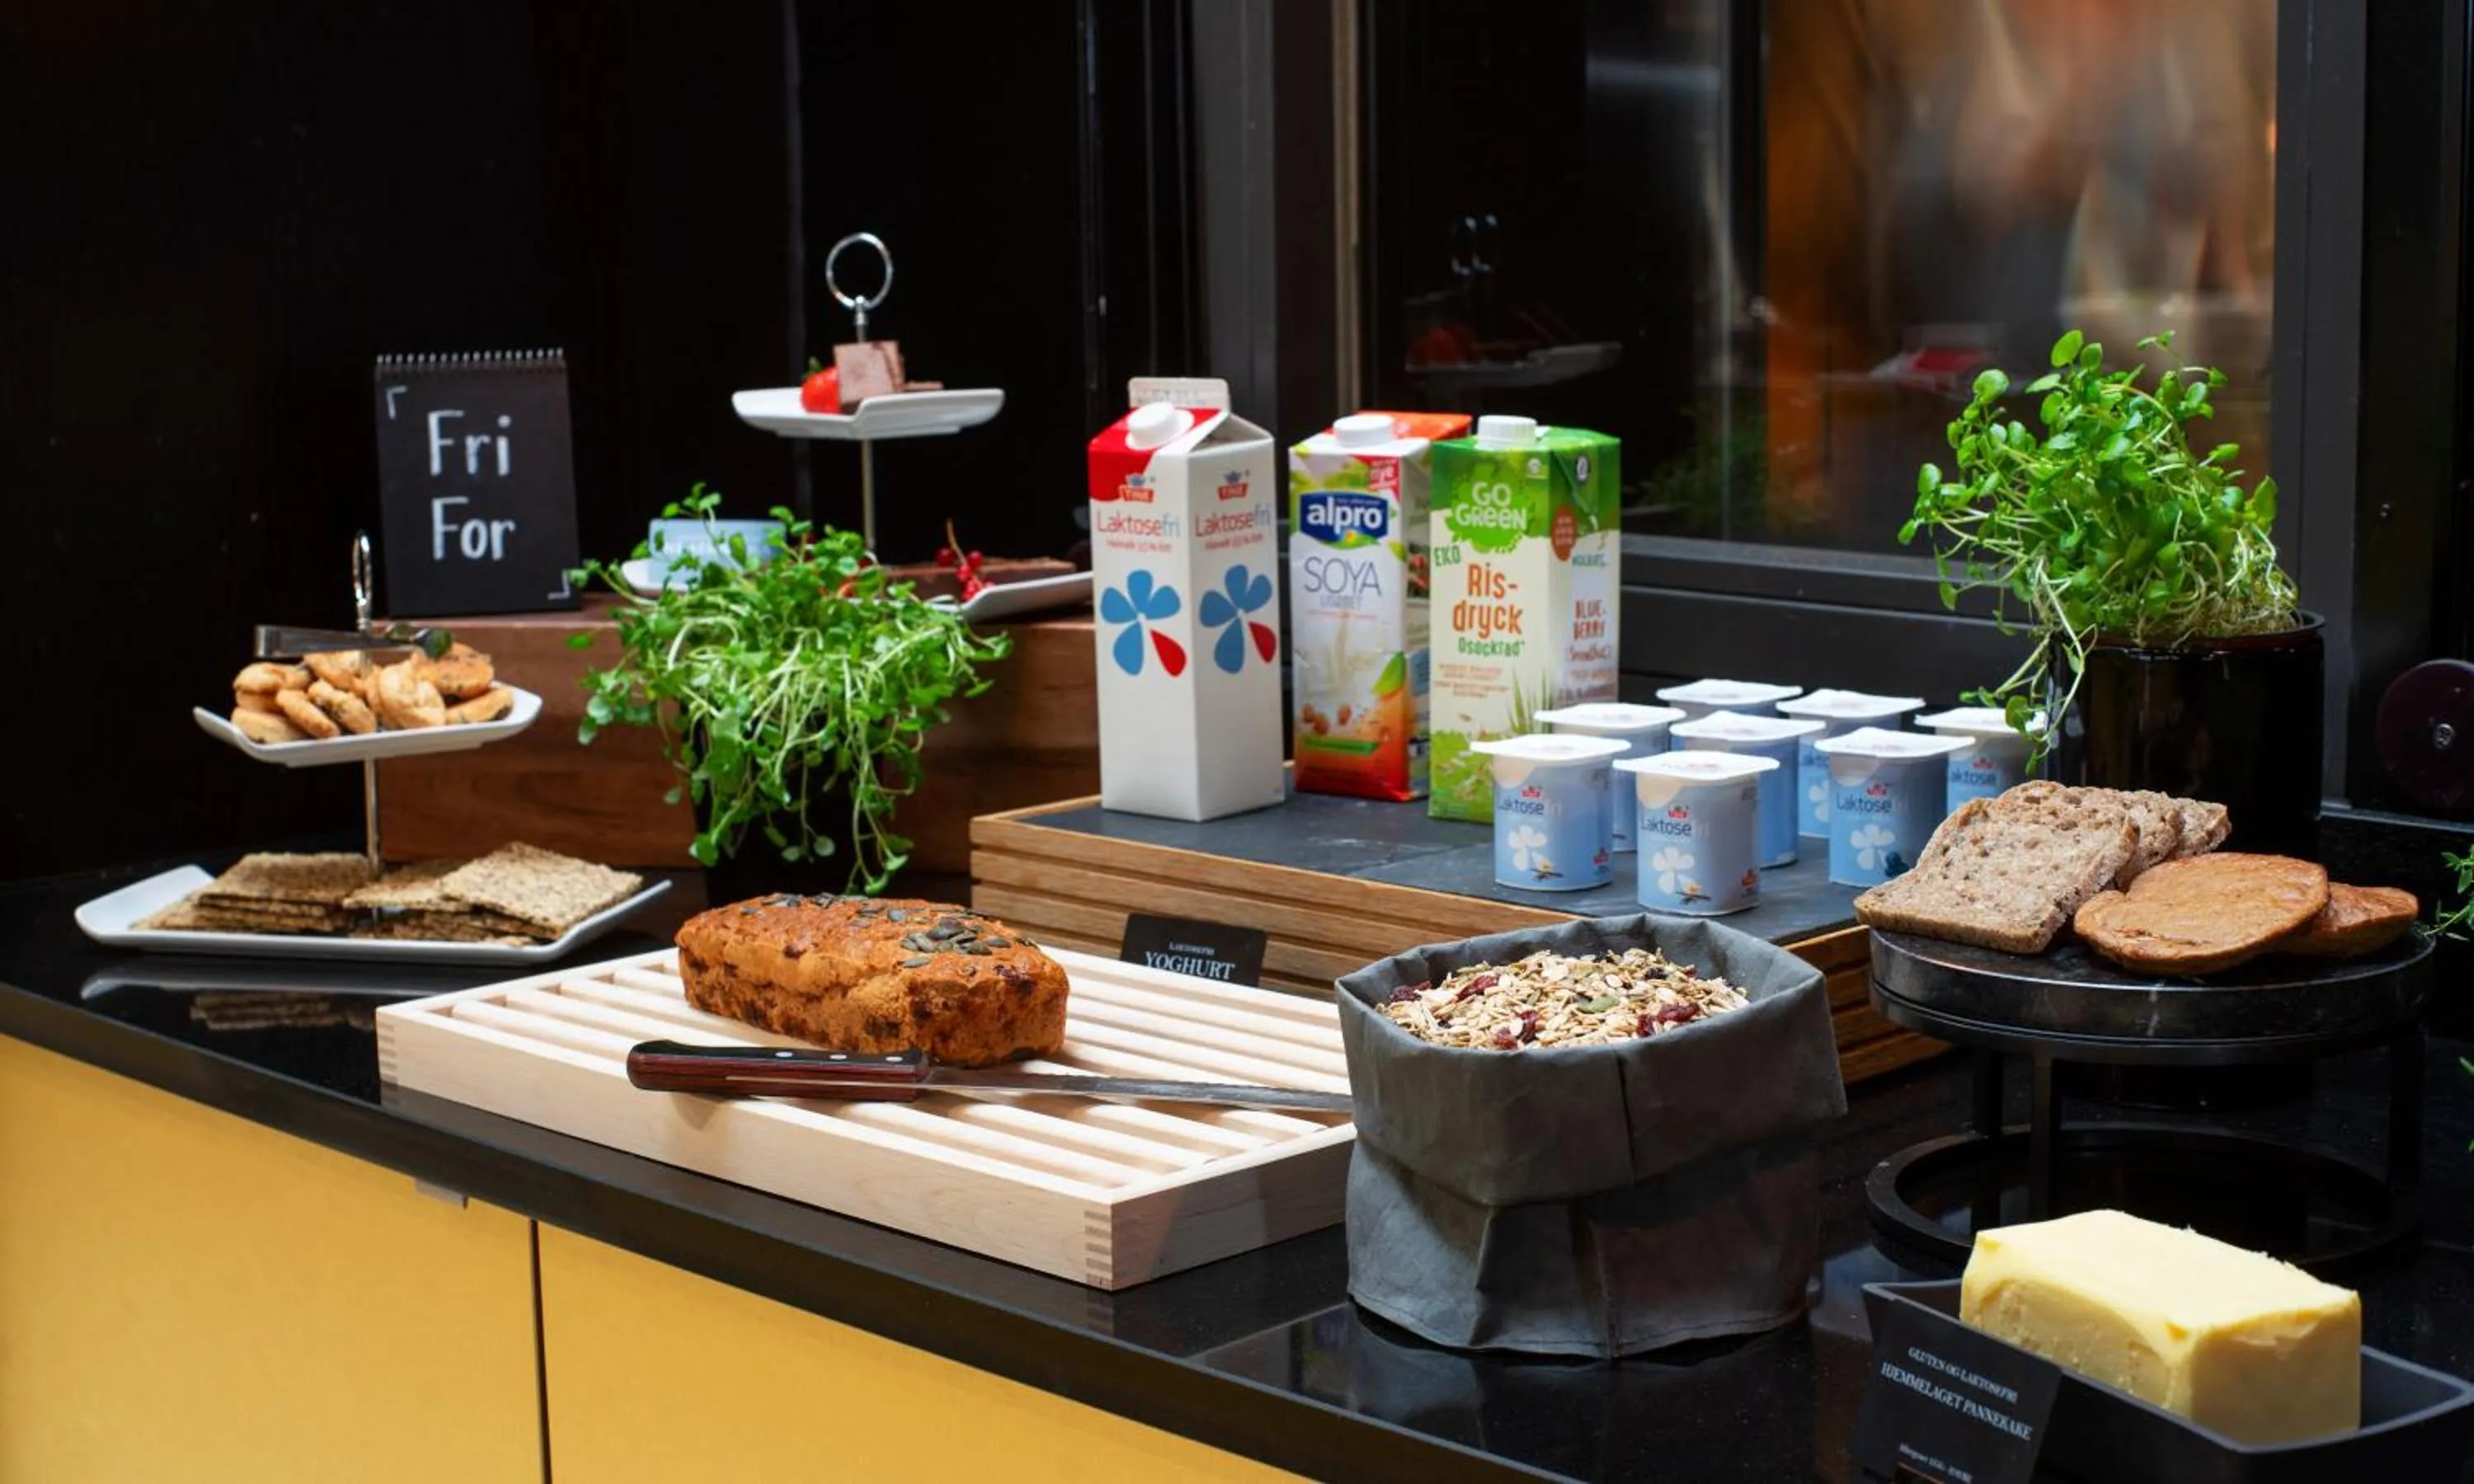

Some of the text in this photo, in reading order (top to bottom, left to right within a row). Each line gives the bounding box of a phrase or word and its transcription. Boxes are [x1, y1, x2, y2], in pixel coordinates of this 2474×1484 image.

[427, 409, 512, 477] Fri
[1472, 481, 1512, 507] GO
[430, 495, 517, 561] For
[1096, 509, 1180, 538] Laktosefri
[1195, 504, 1272, 537] Laktosefri
[1306, 496, 1383, 535] alpro
[1434, 545, 1461, 567] EKO
[1303, 556, 1382, 596] SOYA
[1468, 562, 1518, 599] Ris-
[1452, 599, 1523, 639] dryck
[1950, 768, 1997, 786] aktose
[1145, 951, 1235, 980] YOGHURT
[1907, 1345, 1945, 1373] GLUTEN
[1945, 1363, 1961, 1378] OG
[1880, 1361, 2033, 1440] HJEMMELAGET PANNEKAKE
